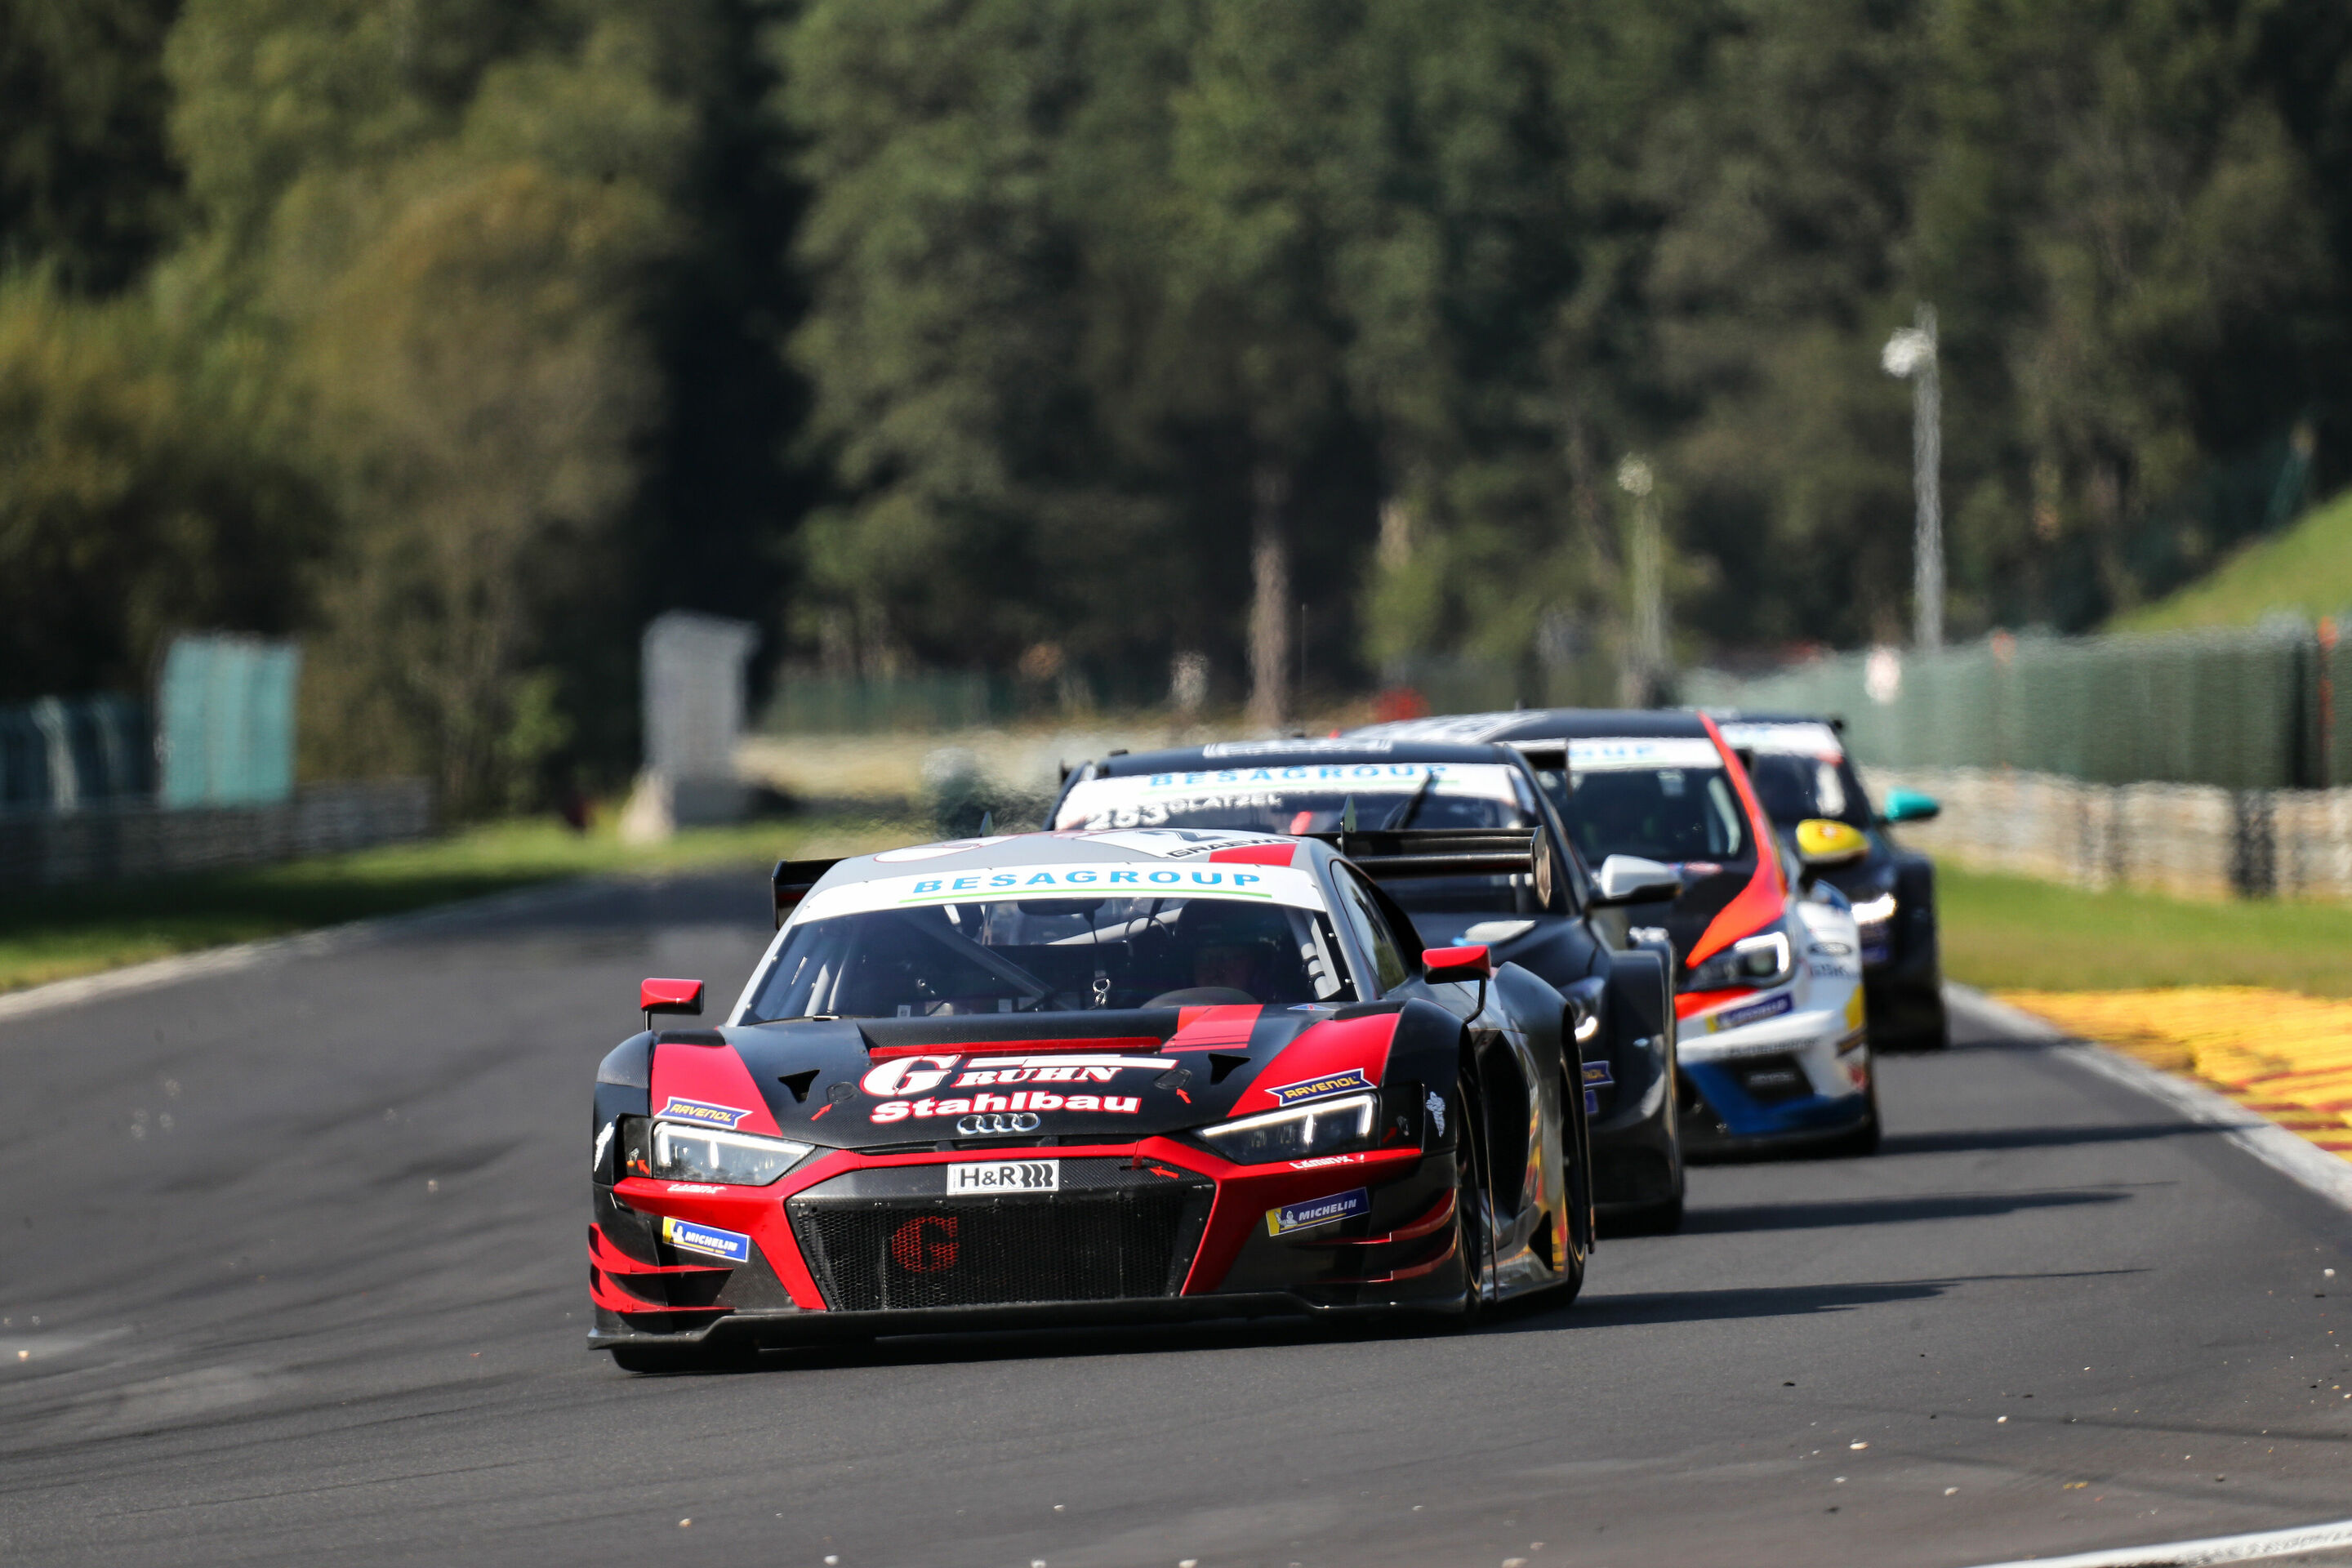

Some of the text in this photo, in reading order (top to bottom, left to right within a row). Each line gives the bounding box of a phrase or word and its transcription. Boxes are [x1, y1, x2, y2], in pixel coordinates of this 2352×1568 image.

[1149, 764, 1448, 786] BESAGROUP
[912, 870, 1260, 894] BESAGROUP
[1283, 1076, 1361, 1099] RAVENOL
[669, 1103, 733, 1123] RAVENOL
[870, 1090, 1142, 1124] Stahlbau
[960, 1165, 1016, 1187] H&R
[1298, 1198, 1357, 1222] MICHELIN
[684, 1232, 739, 1252] MICHELIN
